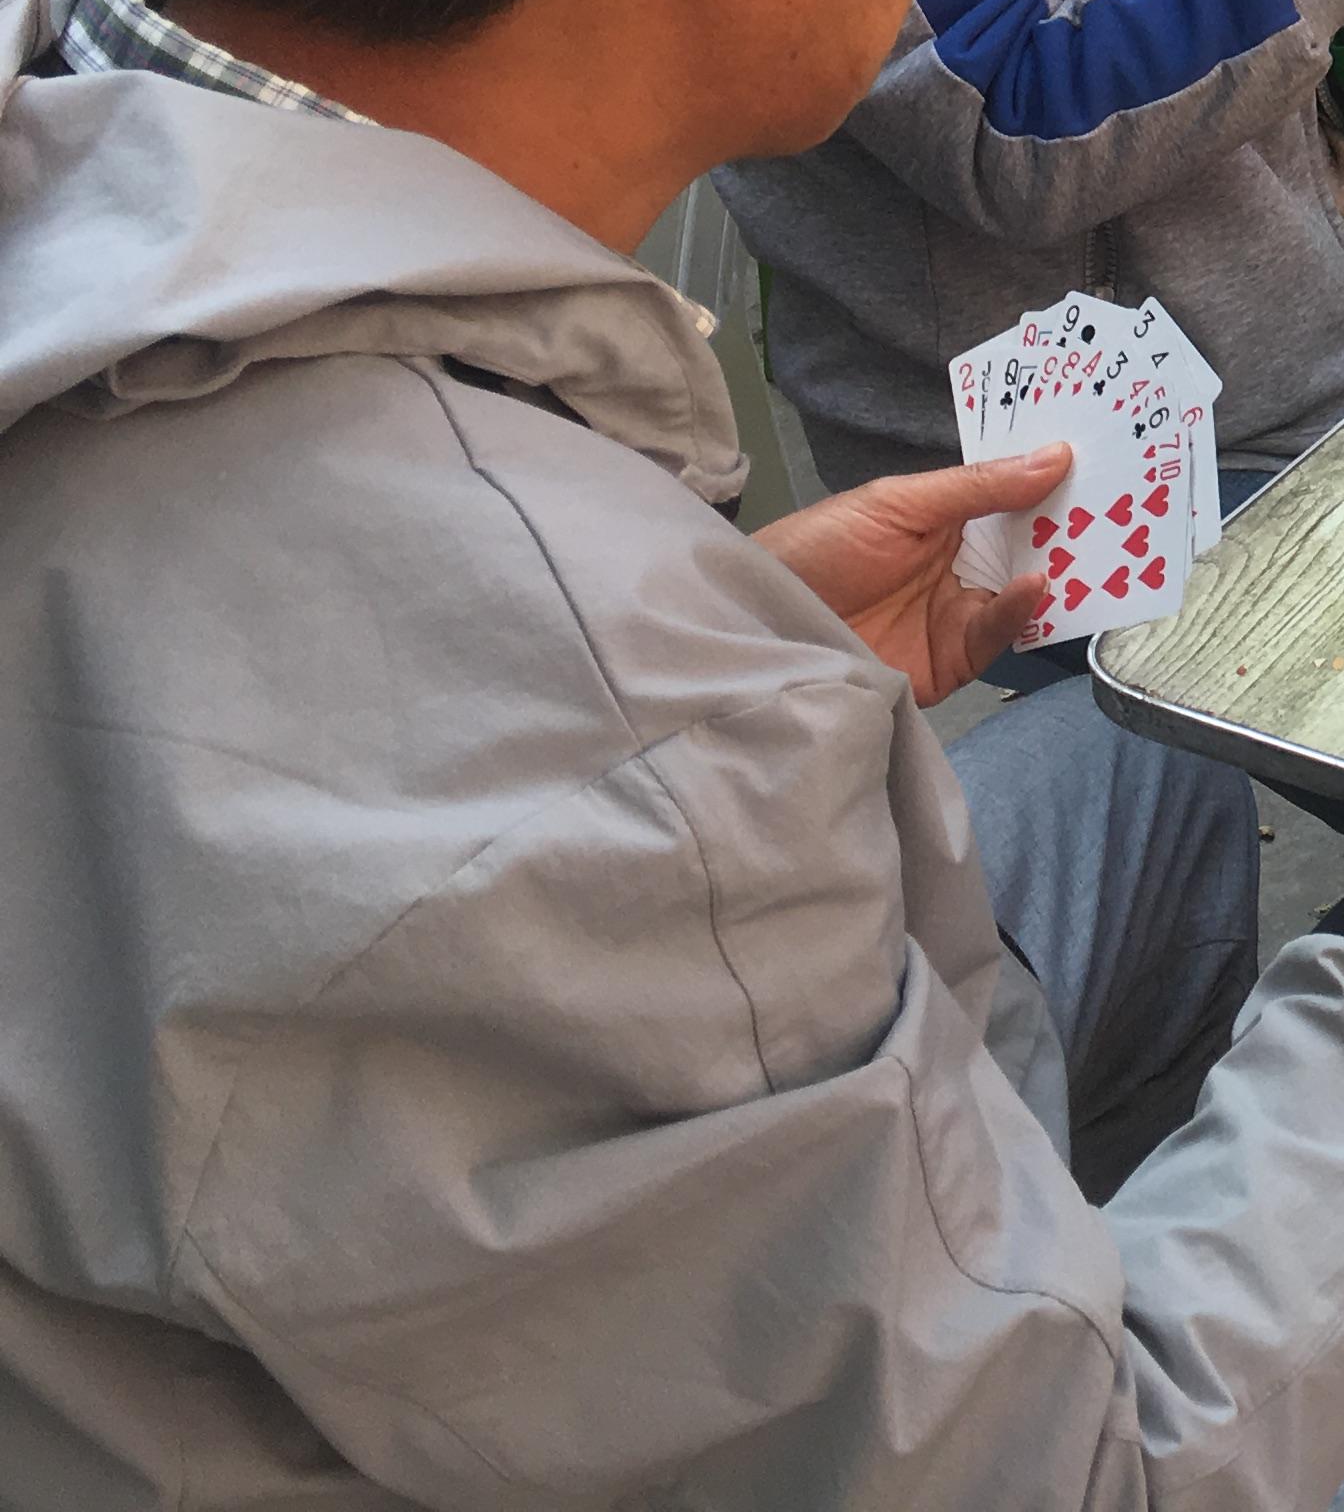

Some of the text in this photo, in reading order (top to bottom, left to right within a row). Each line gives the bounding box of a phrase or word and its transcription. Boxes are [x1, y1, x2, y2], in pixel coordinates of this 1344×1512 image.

[1062, 304, 1080, 332] 9
[1133, 309, 1156, 338] 3
[959, 363, 975, 392] 2
[1004, 358, 1019, 386] Q
[1082, 350, 1103, 378] A
[1107, 350, 1129, 379] 3
[1149, 407, 1170, 429] 6
[1159, 433, 1180, 450] 7
[1160, 459, 1181, 481] 10
